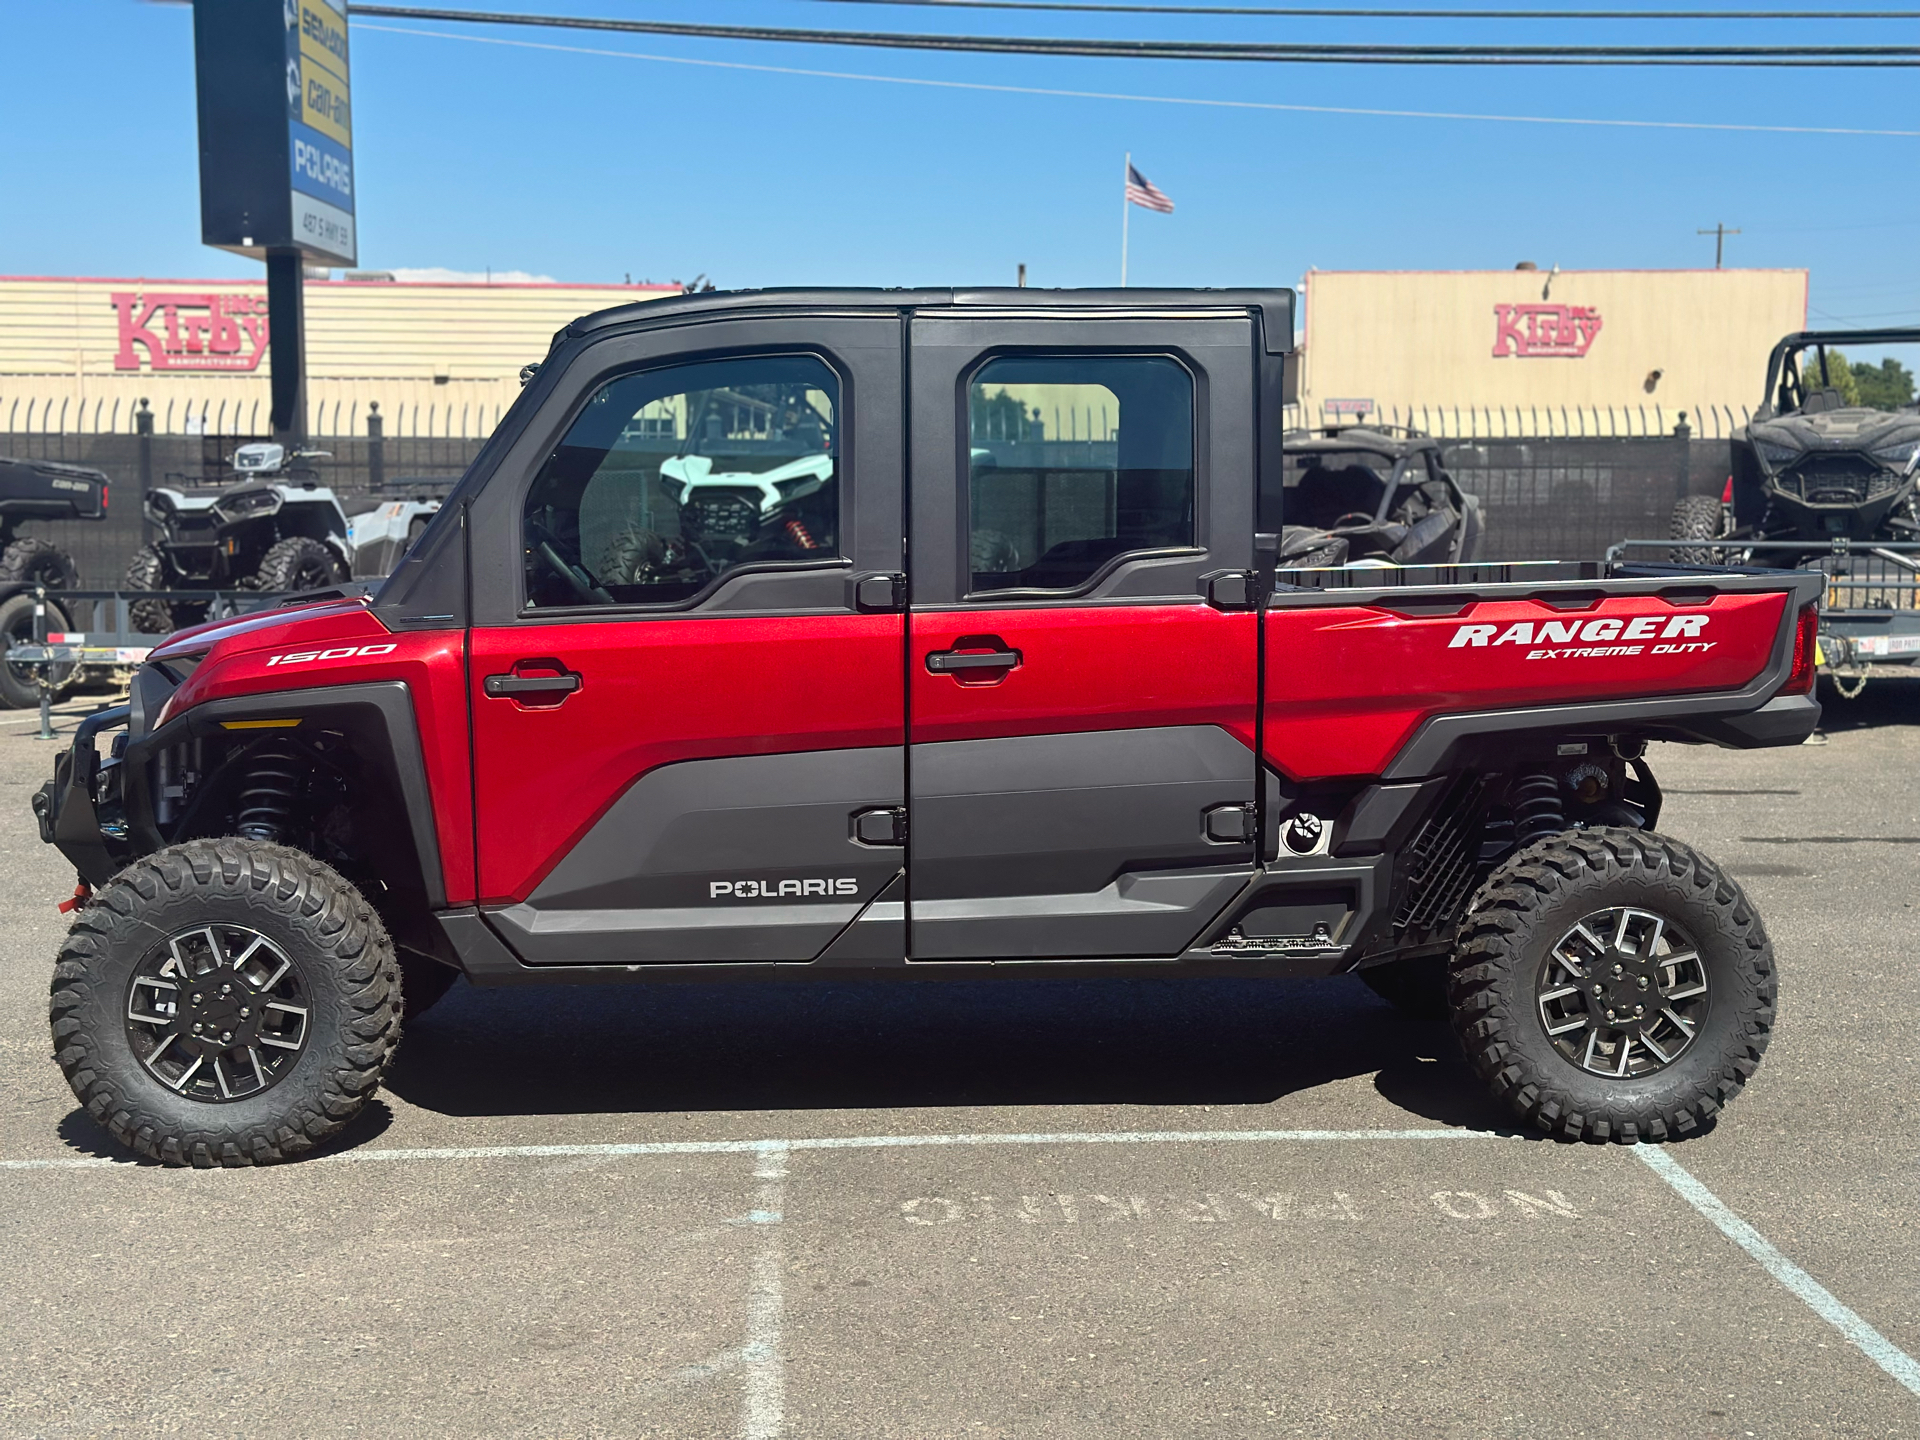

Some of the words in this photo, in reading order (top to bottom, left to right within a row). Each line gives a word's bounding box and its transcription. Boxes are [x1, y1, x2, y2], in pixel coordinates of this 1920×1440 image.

[294, 138, 350, 196] POLARIS
[110, 292, 270, 372] Kirby
[1492, 304, 1603, 357] Kirby
[167, 357, 250, 366] MANUFACTURING
[1447, 614, 1710, 648] RANGER
[266, 643, 398, 667] 1500
[1525, 645, 1644, 660] EXTREME
[1650, 641, 1718, 654] DUTY
[709, 877, 859, 899] POLARIS
